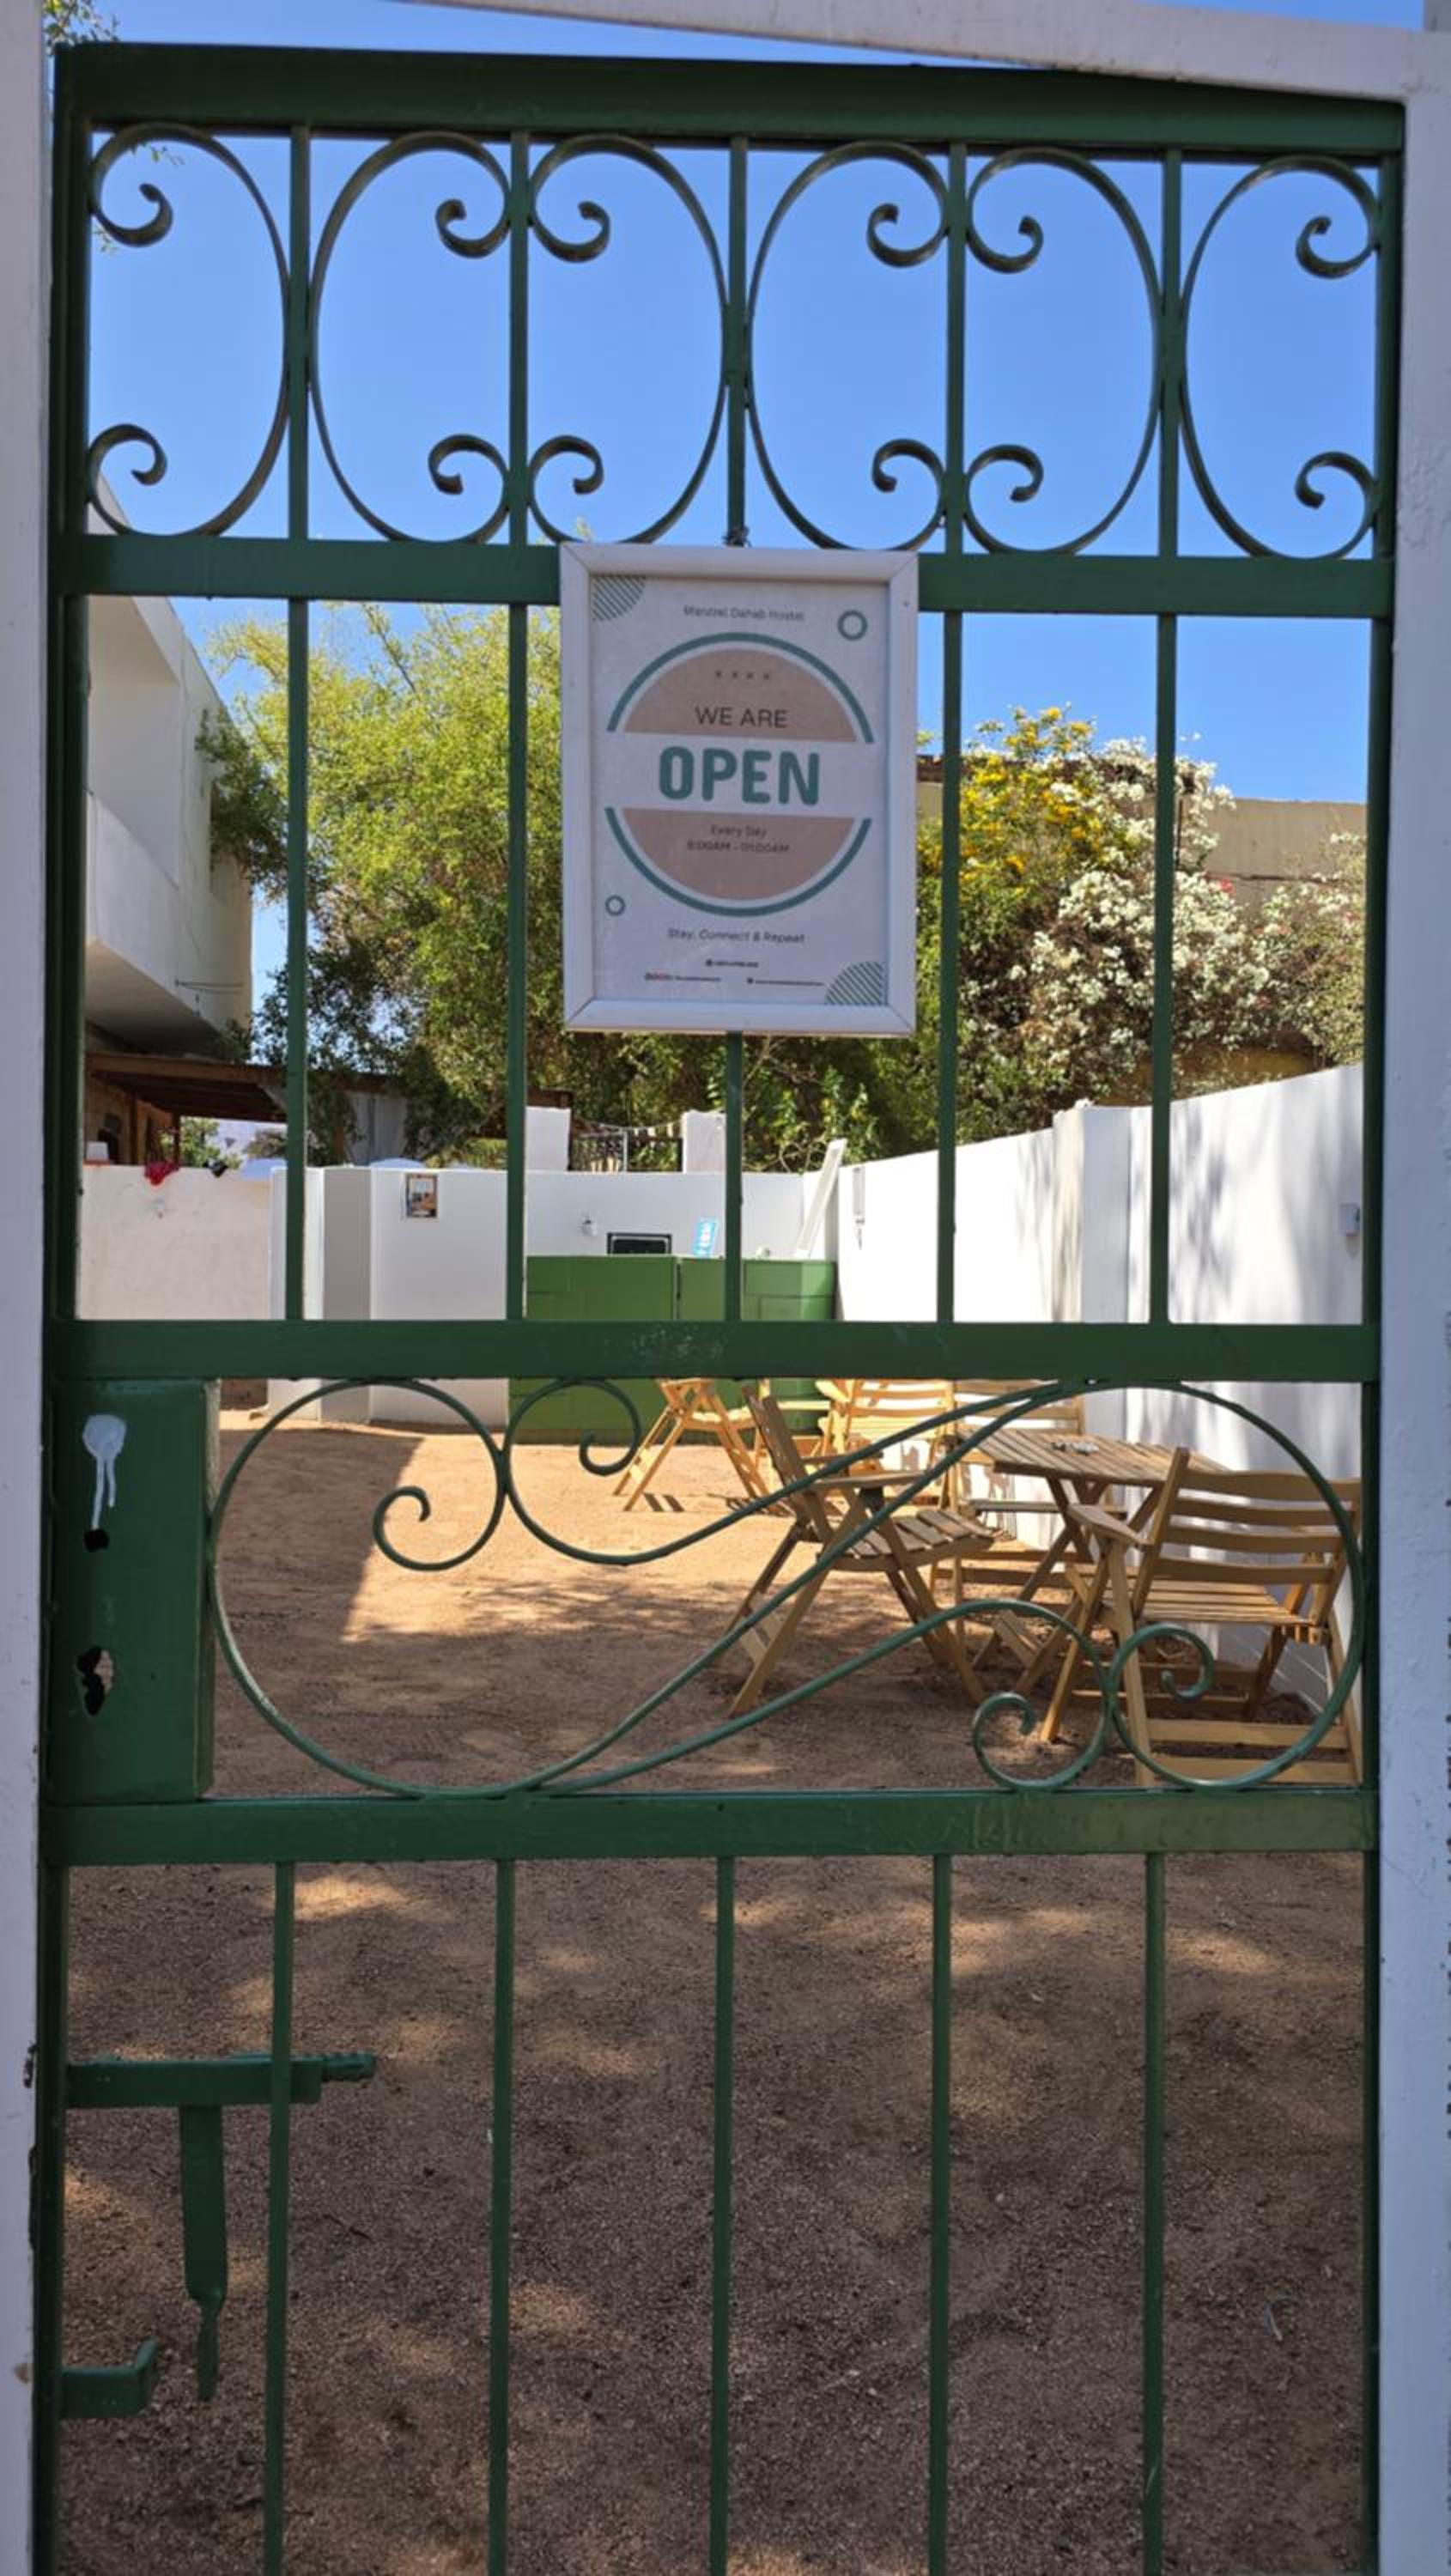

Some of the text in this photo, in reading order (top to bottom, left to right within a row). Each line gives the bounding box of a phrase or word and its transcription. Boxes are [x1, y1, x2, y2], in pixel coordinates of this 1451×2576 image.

[695, 706, 788, 728] WE ARE
[659, 745, 820, 806] OPEN
[711, 824, 767, 839] Every Day
[699, 928, 750, 941] Connect
[753, 932, 761, 942] &
[763, 931, 805, 944] Repeat
